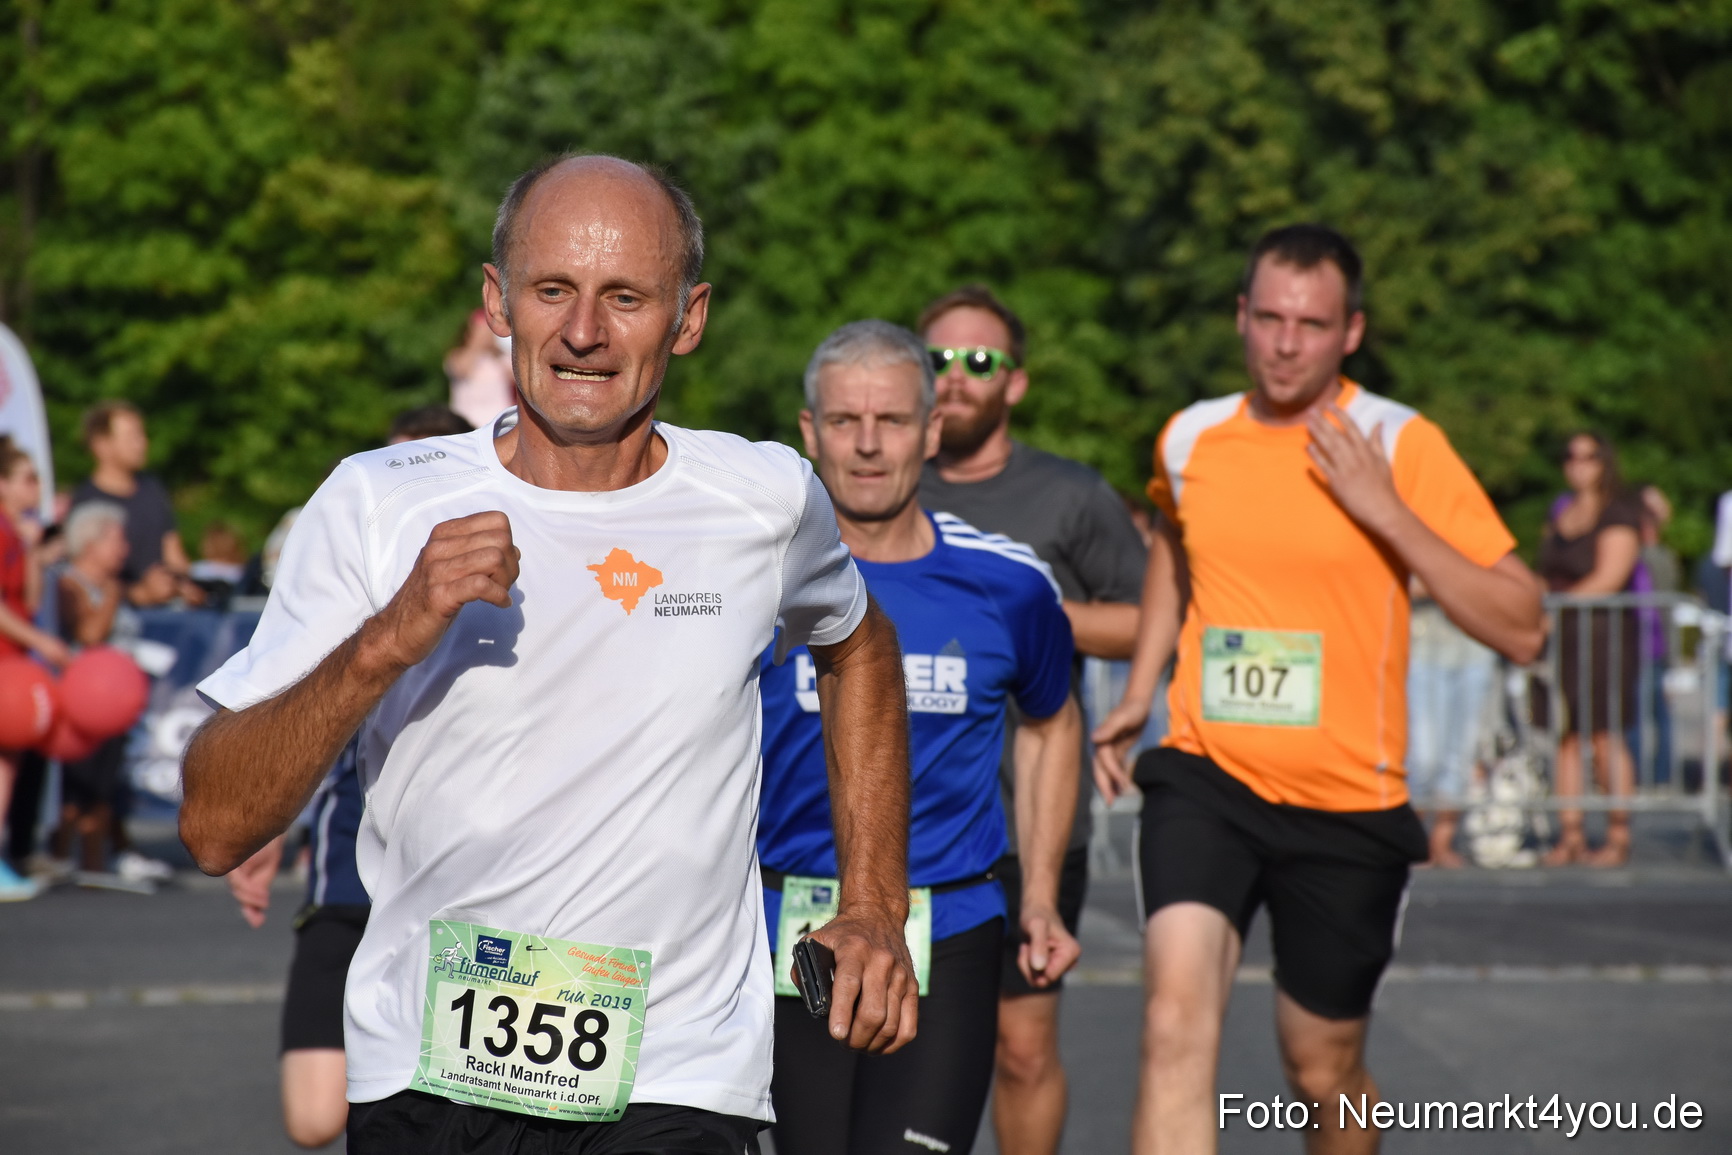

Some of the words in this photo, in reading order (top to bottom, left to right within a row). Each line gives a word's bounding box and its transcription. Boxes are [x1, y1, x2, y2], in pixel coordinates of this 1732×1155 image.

[408, 451, 446, 465] JAKO
[612, 572, 638, 587] NM
[654, 593, 722, 605] LANDKREIS
[654, 605, 722, 617] NEUMARKT
[795, 653, 967, 692] HER
[1224, 664, 1289, 698] 107
[460, 957, 541, 986] firmenlauf
[567, 946, 607, 964] Gesunde
[608, 958, 637, 973] Firmen
[582, 962, 610, 977] laufen
[458, 974, 491, 986] neumarkt
[557, 989, 585, 1004] run
[590, 993, 632, 1010] 2019
[450, 988, 610, 1071] 1358
[466, 1055, 506, 1077] Rackl
[510, 1064, 579, 1089] Manfred
[440, 1069, 501, 1091] Landratsamt
[504, 1083, 557, 1101] Neumarkt
[560, 1091, 601, 1106] i.d.OPf.
